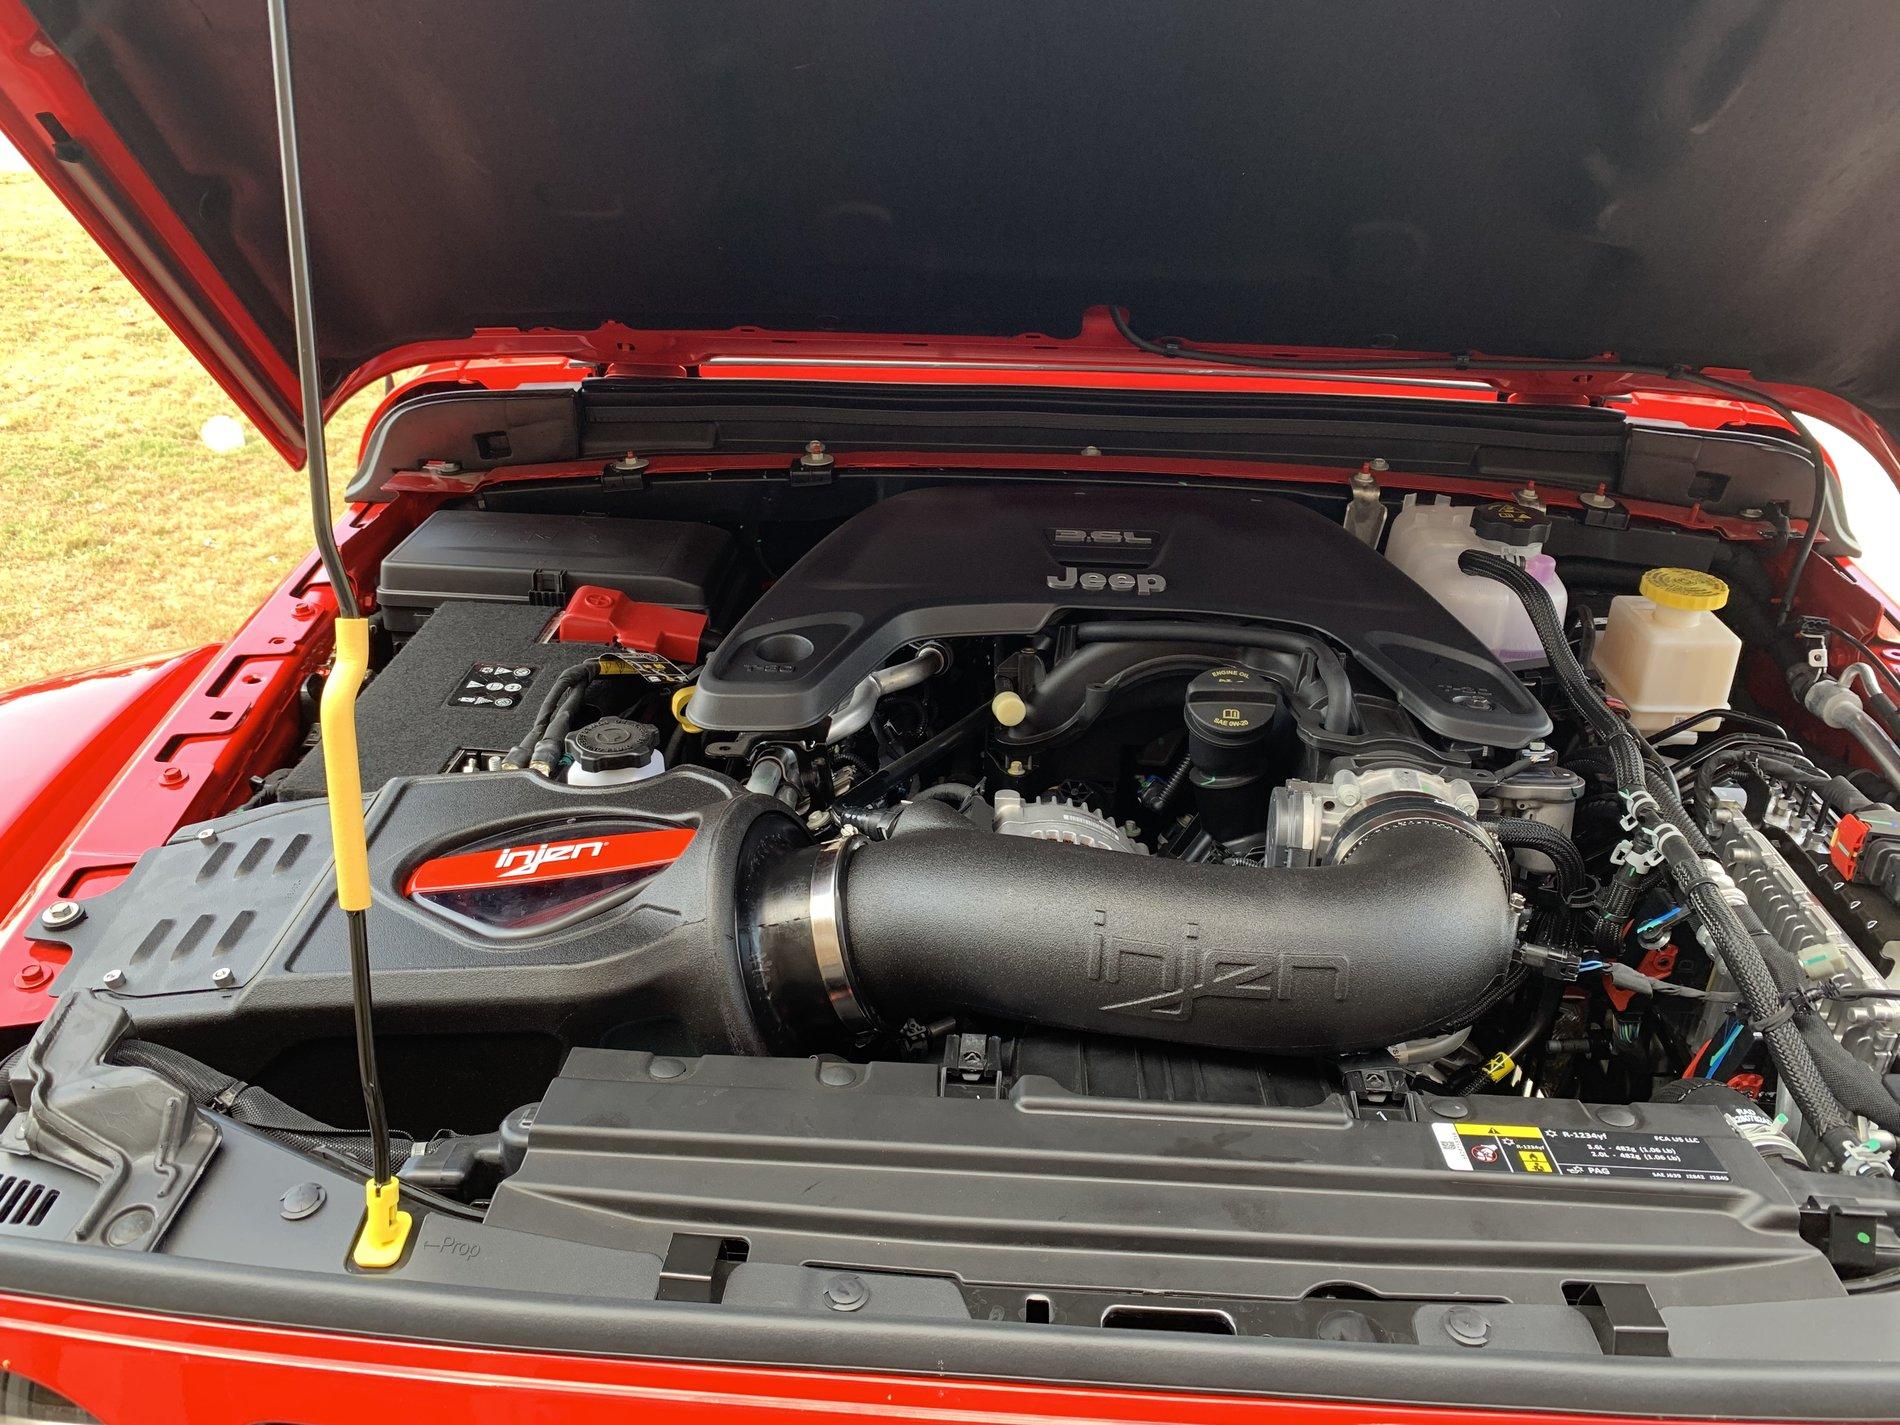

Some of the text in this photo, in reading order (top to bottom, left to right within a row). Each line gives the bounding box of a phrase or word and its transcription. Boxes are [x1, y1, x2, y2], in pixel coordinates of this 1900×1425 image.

[1055, 529, 1152, 544] 3.6L
[1046, 567, 1167, 596] Jeep
[1238, 671, 1250, 679] OIL
[1213, 717, 1228, 726] SAE
[495, 841, 604, 878] injen
[1562, 1130, 1608, 1141] R-1234yf
[1588, 1166, 1611, 1175] PAG
[440, 1236, 481, 1261] Prop
